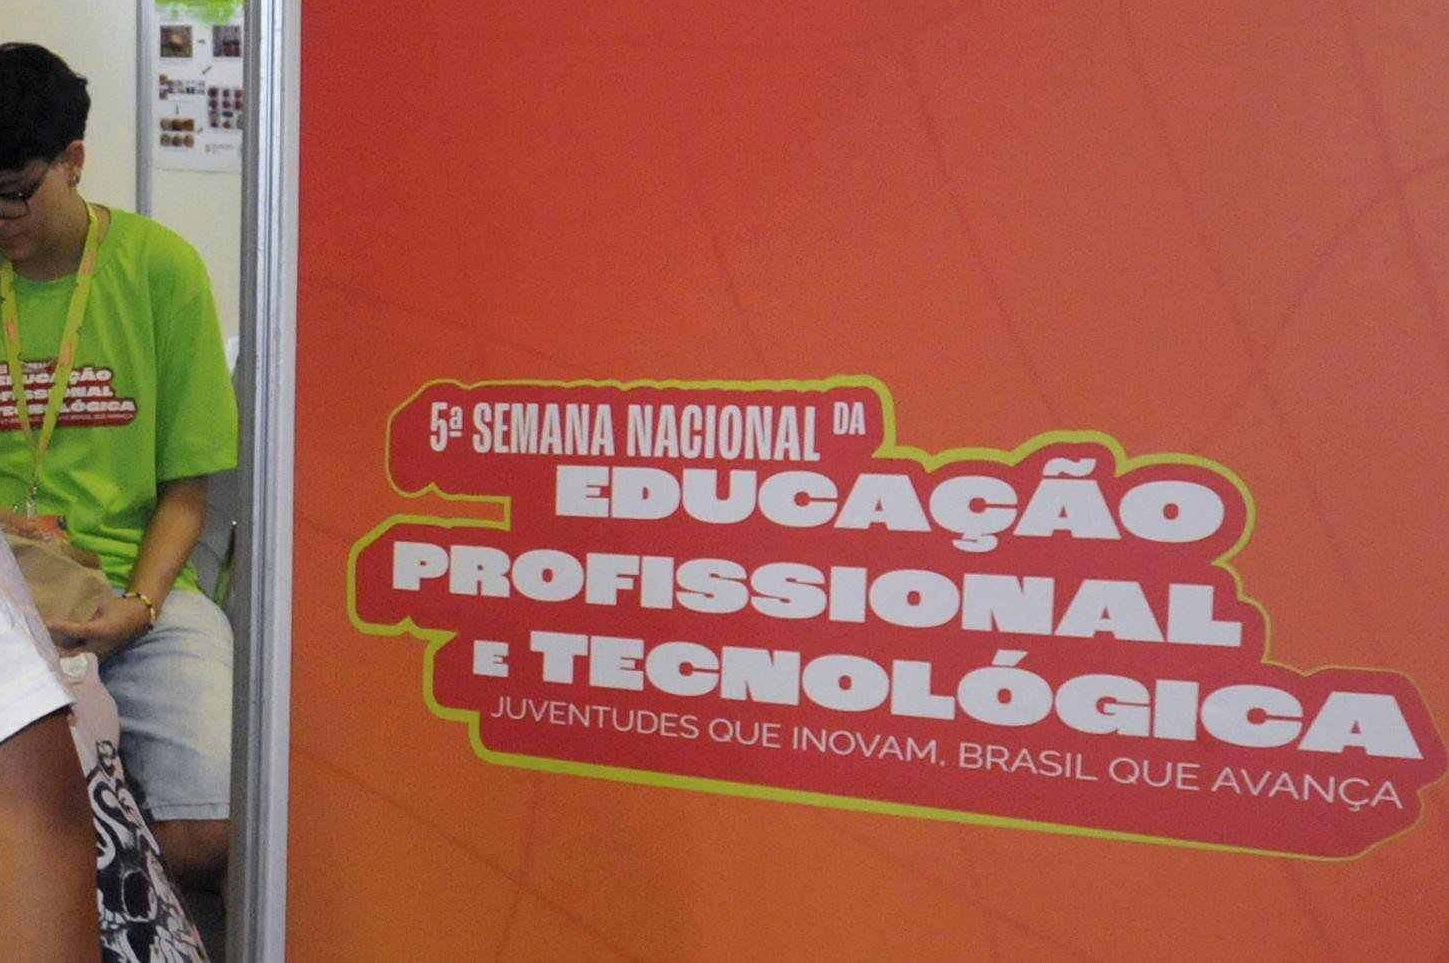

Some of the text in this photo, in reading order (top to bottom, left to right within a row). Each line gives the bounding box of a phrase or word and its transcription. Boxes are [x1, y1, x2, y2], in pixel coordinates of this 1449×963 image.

[473, 402, 615, 457] SEMANA
[627, 404, 820, 461] NACIONAL
[833, 401, 866, 436] DA
[555, 458, 1225, 552] EDUCAÇÃO
[393, 541, 1242, 647] PROFISSIONAL
[472, 630, 1424, 759] E TECNOLÓGICA
[491, 696, 699, 739] JUVENTUDES
[708, 718, 781, 749] QUE
[959, 743, 1097, 781] BRASIL
[1109, 757, 1201, 791] QUE
[1210, 766, 1403, 812] AVANÇA
